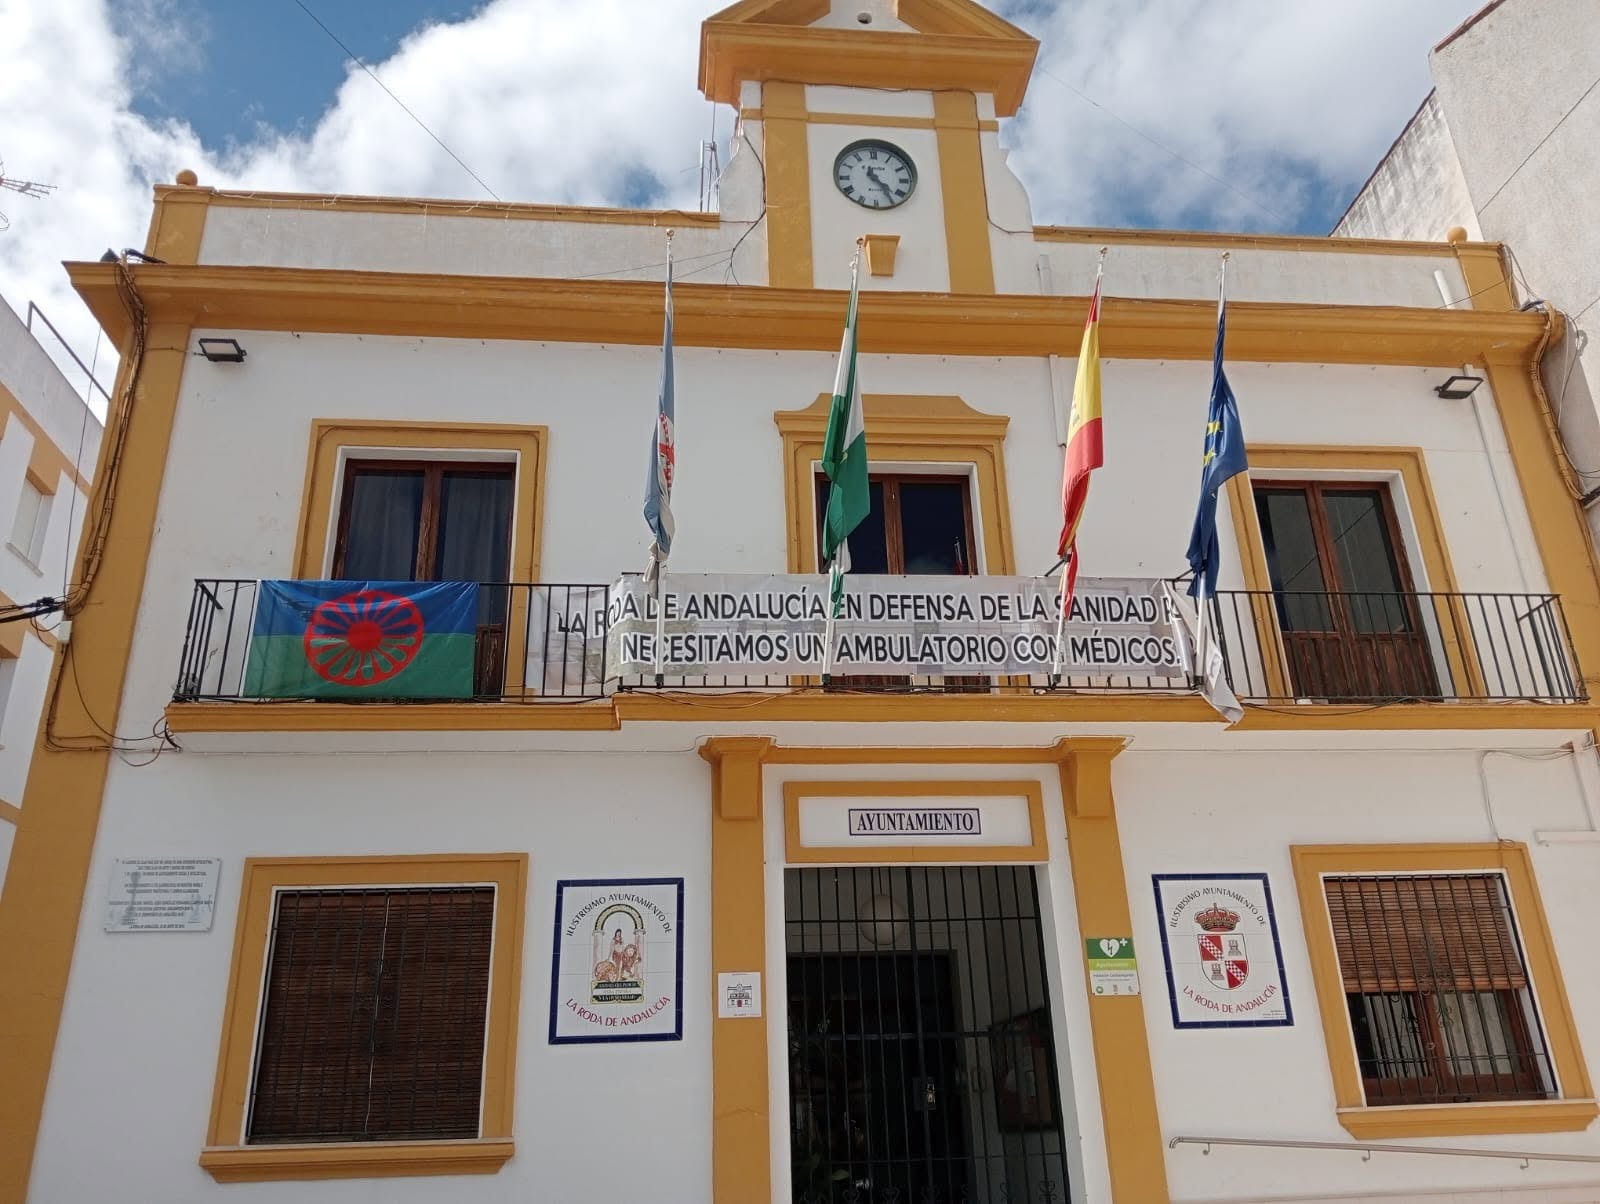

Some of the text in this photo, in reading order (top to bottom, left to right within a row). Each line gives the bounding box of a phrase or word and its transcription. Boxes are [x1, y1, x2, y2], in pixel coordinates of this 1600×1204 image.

[558, 612, 586, 634] LA
[684, 586, 827, 619] ANDALUCÍA
[870, 594, 974, 621] DEFENSA
[981, 594, 1010, 621] DE
[1017, 594, 1049, 621] LA
[1054, 594, 1157, 622] SANIDAD
[622, 628, 1181, 665] NECESITAMOS UN AMBULATORIO CON MÉDICOS.
[857, 812, 974, 831] AYUNTAMIENTO
[608, 893, 666, 922] AYUNTAMIENTO
[662, 922, 673, 935] DE
[1202, 887, 1259, 915] AYUNTAMIENTO
[1256, 915, 1267, 926] DE
[566, 994, 671, 1027] LA RODA DE ANDALUCÍA
[1183, 983, 1277, 1013] LA RODA DE ANDALUCÍA
